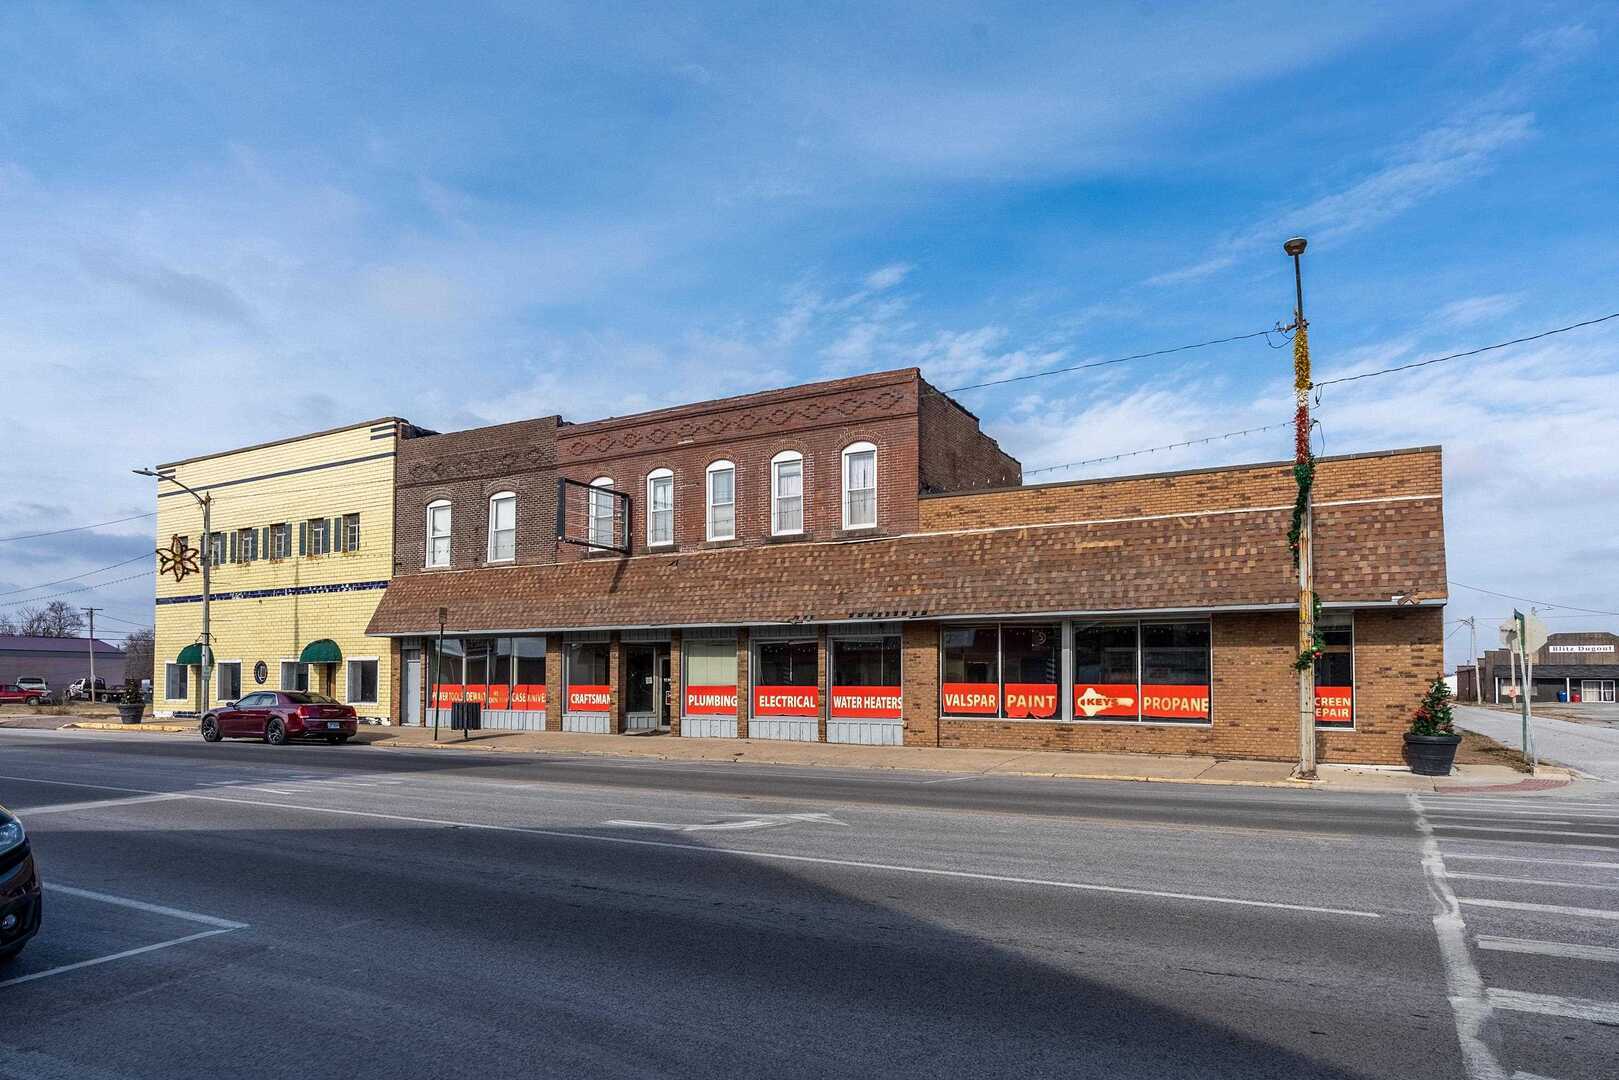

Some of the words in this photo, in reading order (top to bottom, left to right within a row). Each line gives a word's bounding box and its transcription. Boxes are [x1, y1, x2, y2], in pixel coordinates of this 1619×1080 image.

[512, 692, 526, 703] CASE
[528, 693, 546, 703] KNIVE
[570, 693, 610, 705] CRAFTSMAN
[688, 695, 738, 707] PLUMBING
[759, 695, 816, 708] ELECTRICAL
[833, 695, 862, 709] WATER
[864, 696, 903, 710] HEATERS
[945, 693, 996, 708] VALSPAR
[1007, 694, 1056, 709] PAINT
[1315, 697, 1351, 706] CREEN
[1143, 696, 1209, 712] PROPANE
[1316, 708, 1349, 717] EPAIR
